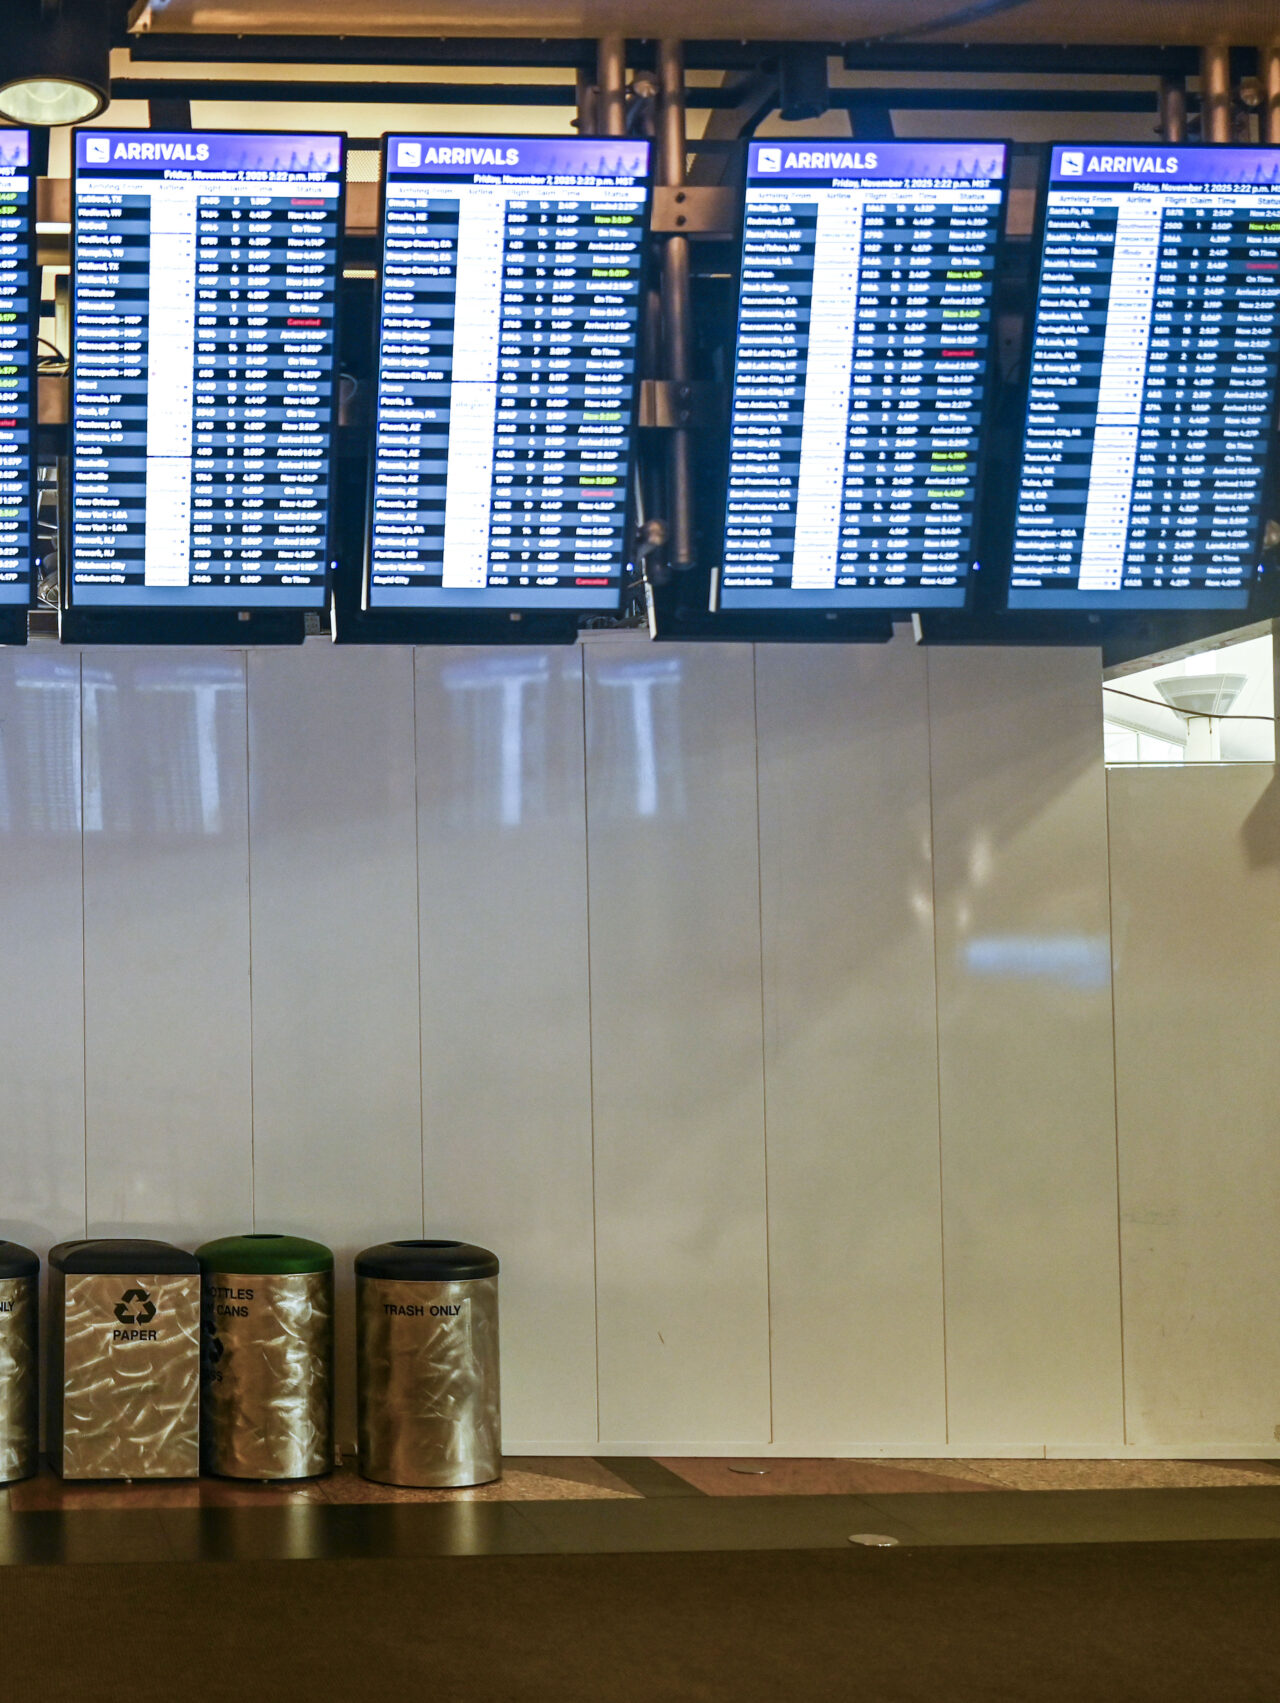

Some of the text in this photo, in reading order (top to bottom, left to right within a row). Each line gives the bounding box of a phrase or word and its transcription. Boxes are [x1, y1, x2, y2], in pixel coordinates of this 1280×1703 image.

[113, 141, 209, 161] ARRIVALS
[424, 146, 519, 165] ARRIVALS
[784, 151, 878, 169] ARRIVALS
[1086, 155, 1179, 174] ARRIVALS
[1160, 183, 1202, 192] November
[1210, 183, 1233, 192] 2025
[1251, 185, 1270, 194] p.m.
[1058, 194, 1090, 203] Arriving
[1126, 195, 1152, 203] Airline
[1164, 196, 1187, 205] Flight
[1189, 196, 1213, 204] Claim
[1217, 196, 1236, 204] Time
[217, 1304, 249, 1317] CANS
[384, 1304, 461, 1317] TRASH ONLY
[113, 1329, 157, 1341] PAPER
